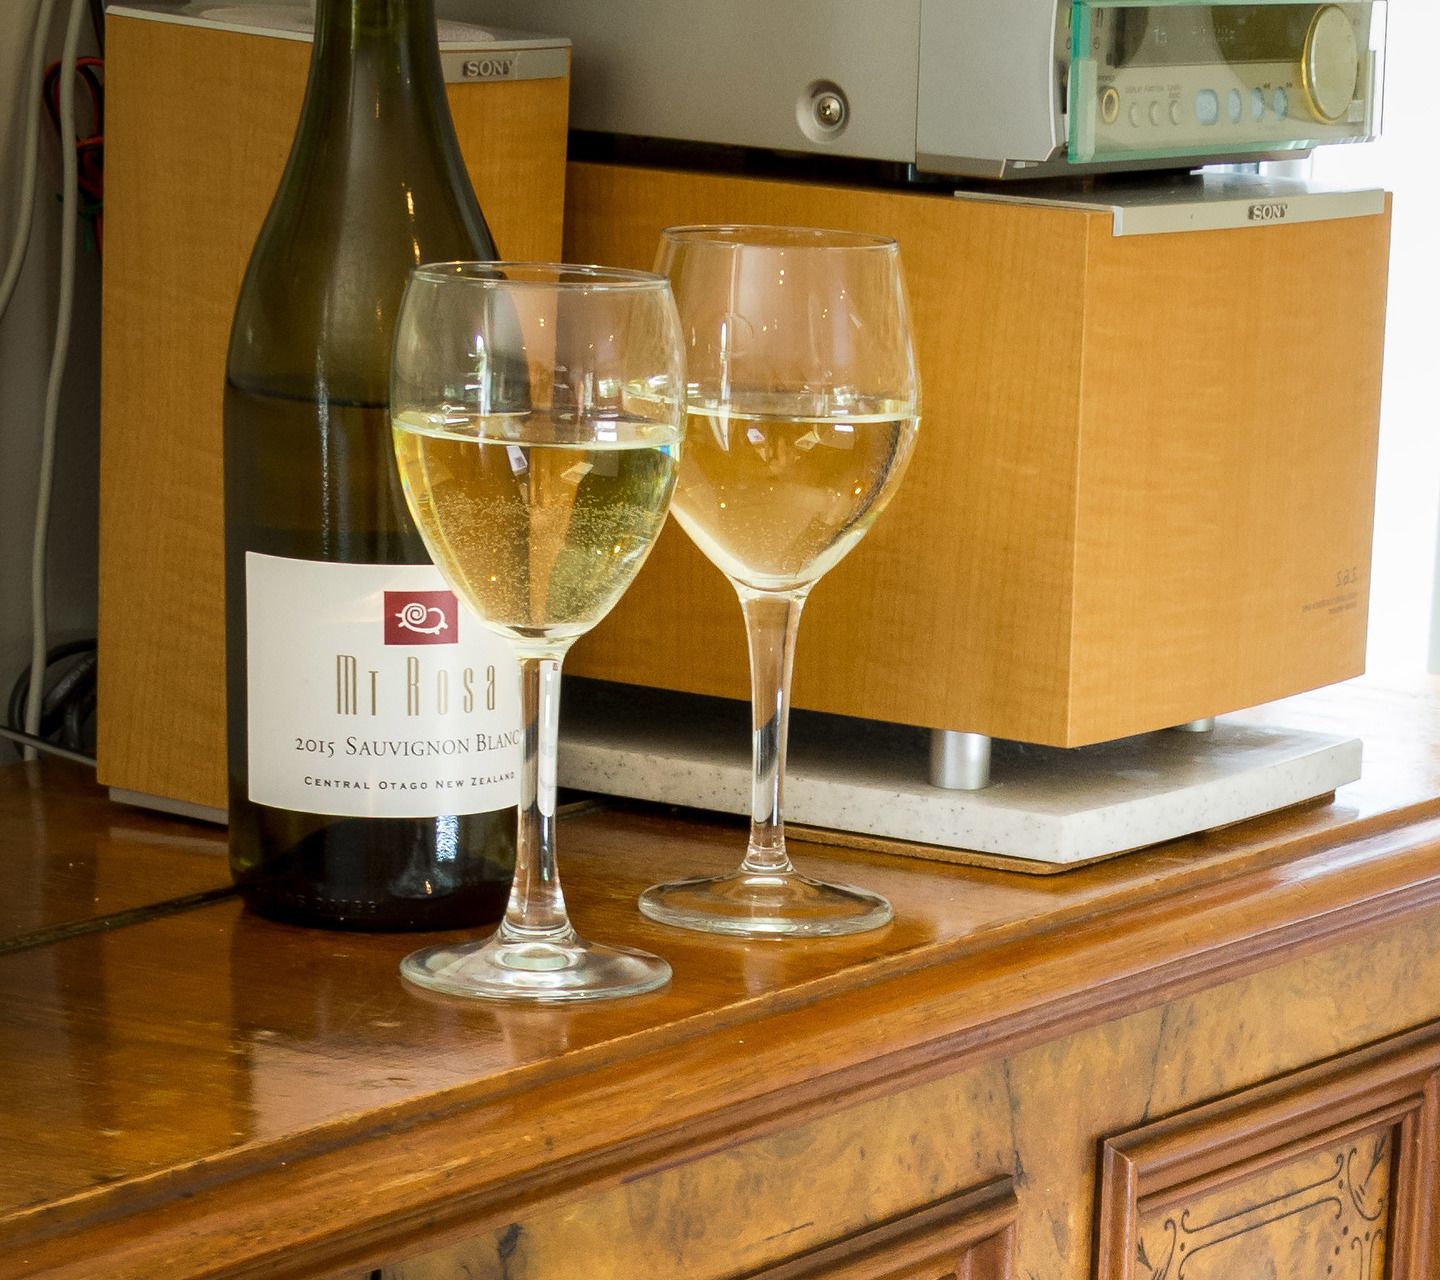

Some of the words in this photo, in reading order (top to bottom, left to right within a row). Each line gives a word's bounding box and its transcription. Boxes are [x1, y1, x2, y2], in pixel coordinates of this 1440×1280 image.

[464, 60, 513, 77] SONY
[1249, 204, 1288, 220] SONY
[295, 737, 335, 758] 2015
[345, 736, 470, 757] SAUVIGNON
[476, 729, 521, 752] BLANC
[304, 776, 370, 790] CENTRAL
[378, 781, 428, 790] OTAGO
[435, 780, 464, 789] NEW
[471, 771, 515, 786] ZEALAND
